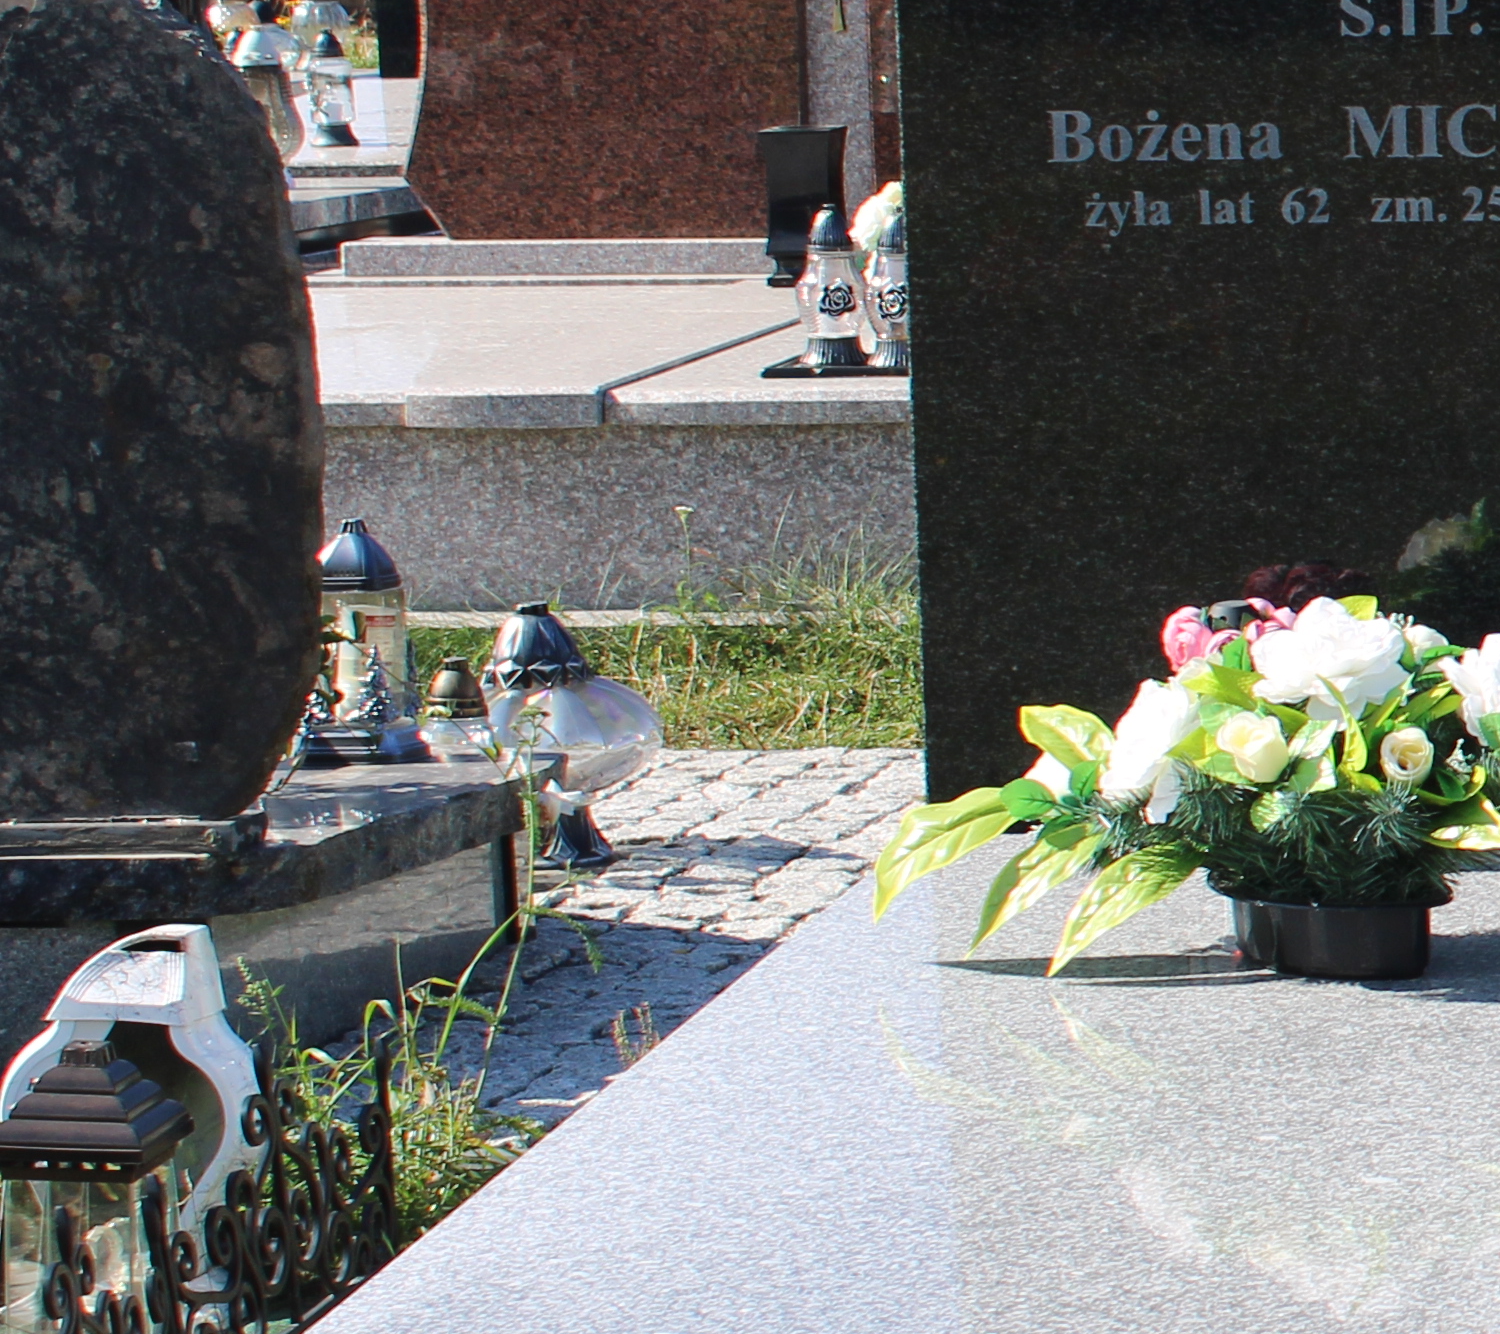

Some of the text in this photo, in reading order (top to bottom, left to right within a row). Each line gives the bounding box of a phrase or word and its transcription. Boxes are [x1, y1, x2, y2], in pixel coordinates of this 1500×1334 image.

[1048, 107, 1283, 162] Bożena
[1199, 187, 1253, 223] lat
[1281, 187, 1329, 223] 62
[1371, 191, 1446, 223] zm.
